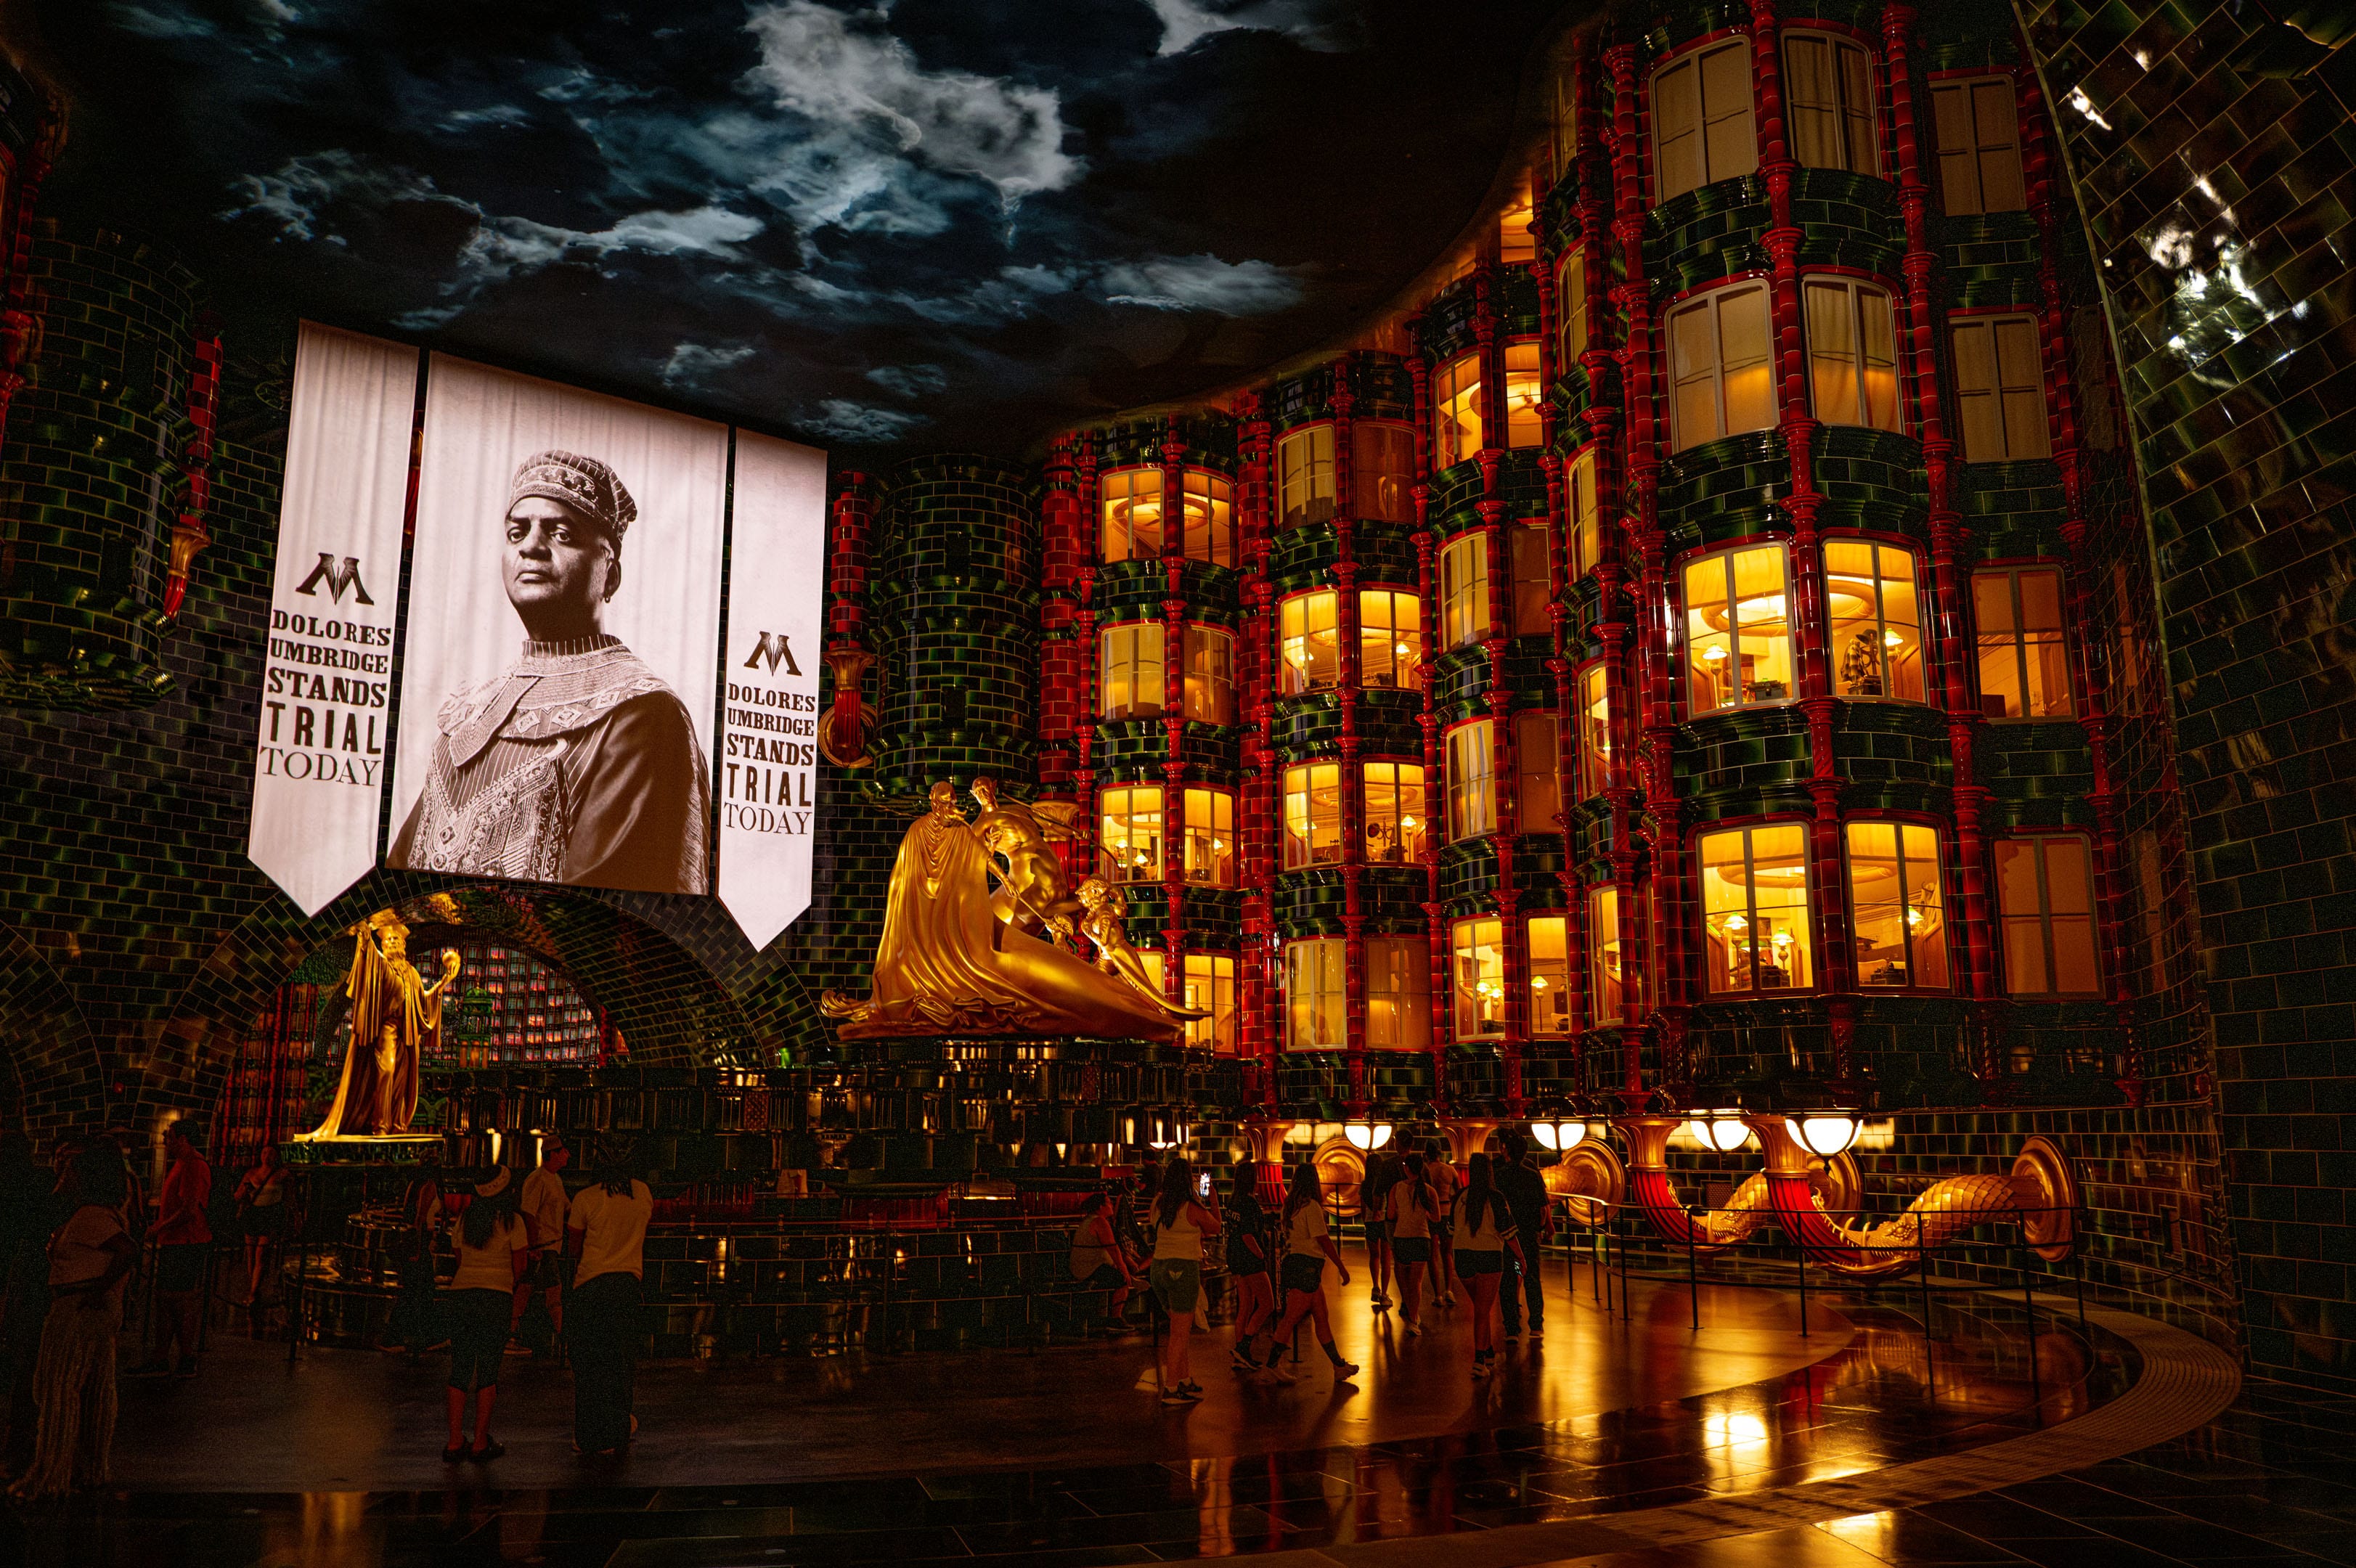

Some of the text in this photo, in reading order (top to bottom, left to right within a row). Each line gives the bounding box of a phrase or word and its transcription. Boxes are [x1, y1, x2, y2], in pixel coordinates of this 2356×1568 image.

[271, 609, 391, 646] DOLORES
[269, 637, 388, 674] UMBRIDGE
[267, 666, 387, 709] STANDS
[728, 682, 815, 712] DOLORES
[266, 701, 381, 754] TRIAL
[727, 707, 815, 737] UMBRIDGE
[259, 746, 382, 787] TODAY
[727, 732, 814, 767] STANDS
[727, 762, 812, 807] TRIAL
[724, 801, 812, 835] TODAY
